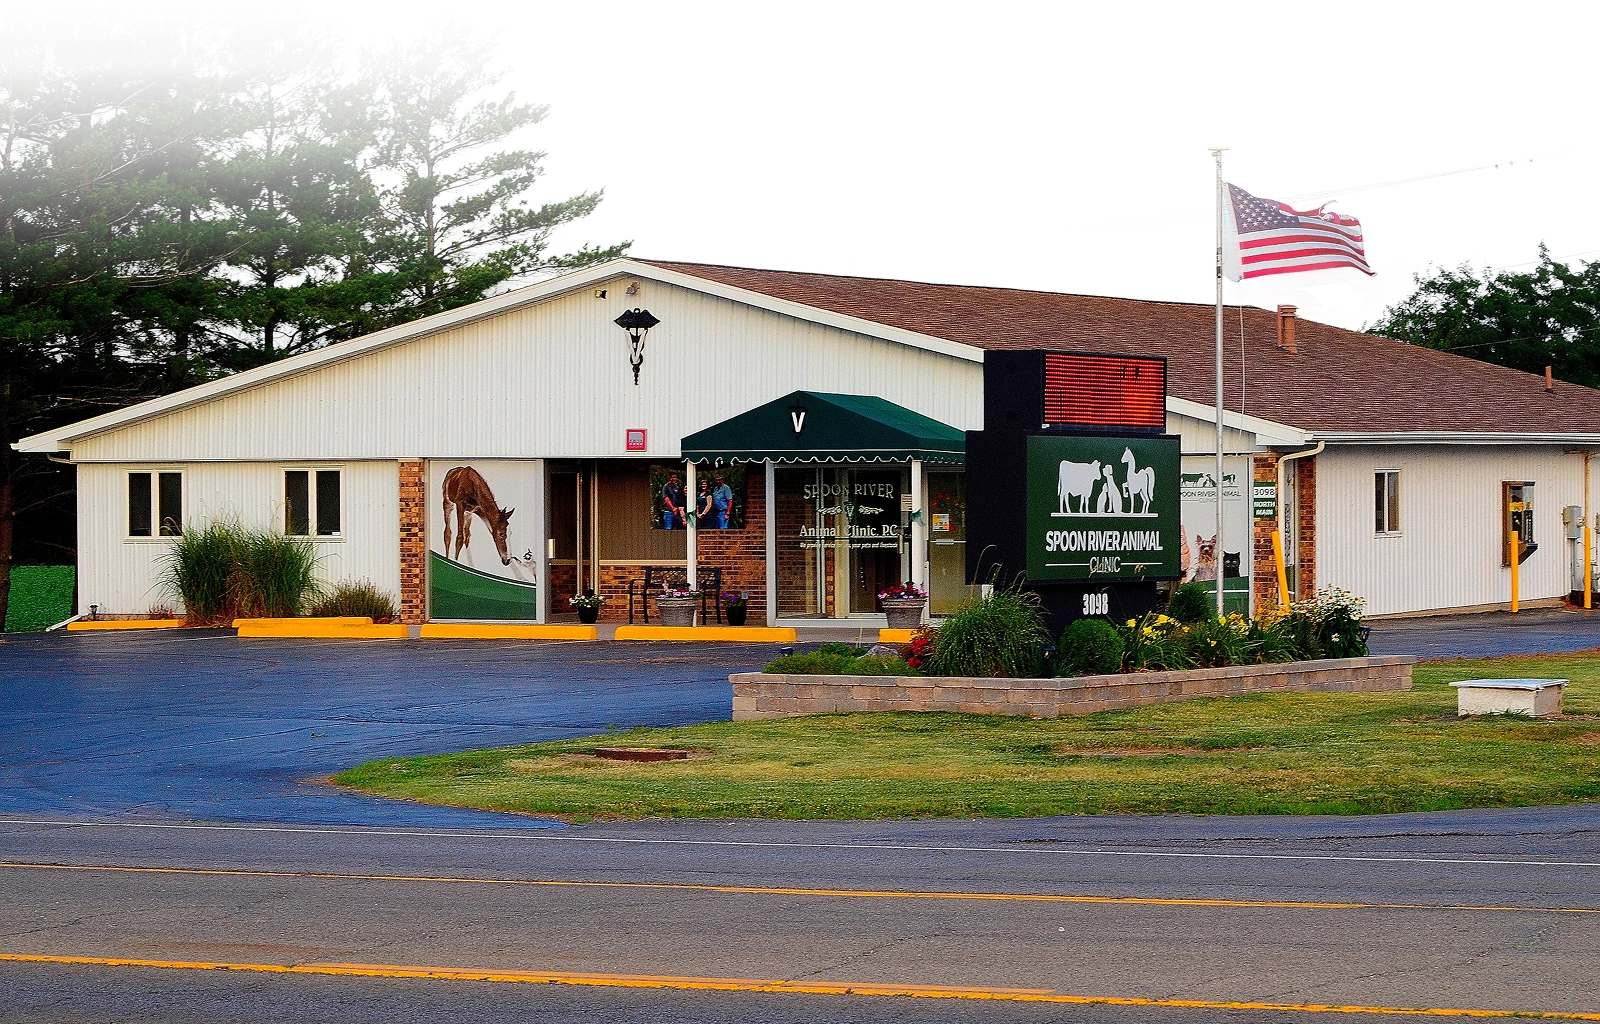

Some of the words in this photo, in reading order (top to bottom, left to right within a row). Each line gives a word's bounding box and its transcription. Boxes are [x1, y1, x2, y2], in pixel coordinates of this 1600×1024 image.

[791, 411, 806, 433] V
[803, 483, 850, 499] SPOON
[854, 483, 894, 499] RIVER
[1180, 490, 1197, 498] OON
[1254, 488, 1275, 496] 3098
[799, 524, 841, 537] Animal
[1045, 530, 1087, 552] SPOON
[1087, 530, 1121, 551] RIVER
[1121, 530, 1164, 551] ANIMAL
[1089, 556, 1121, 573] CLINIC
[1082, 593, 1109, 616] 3098
